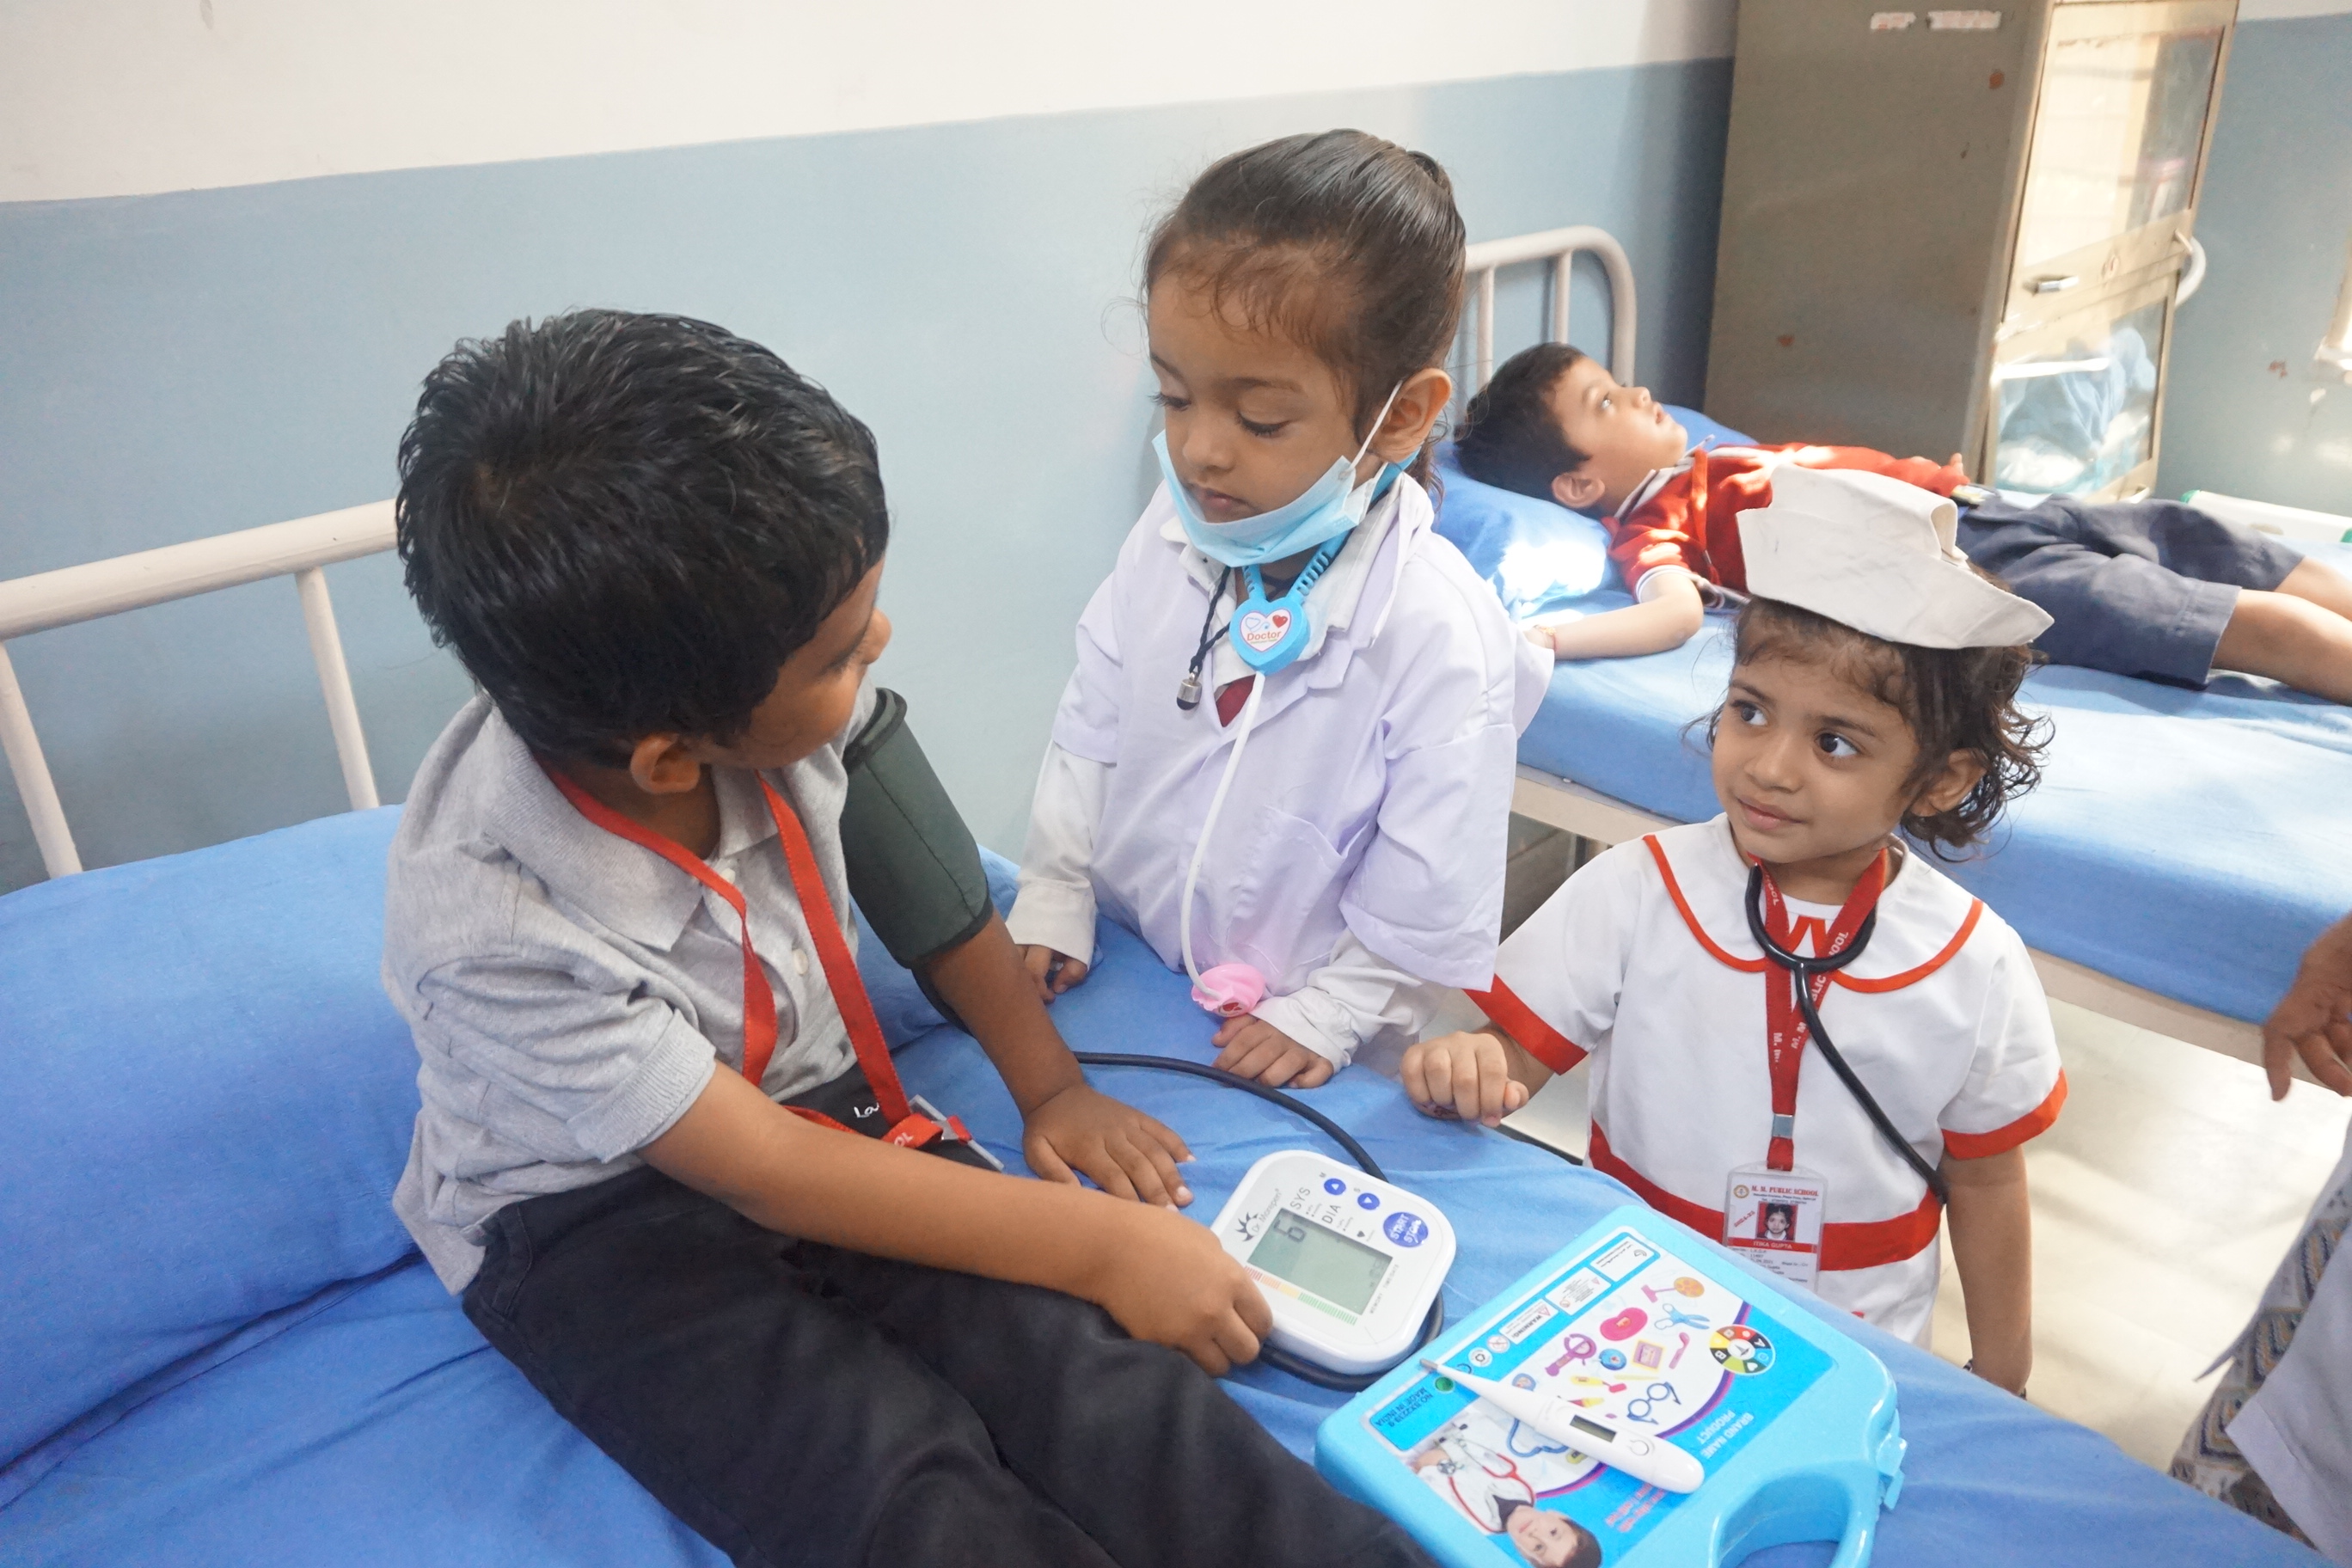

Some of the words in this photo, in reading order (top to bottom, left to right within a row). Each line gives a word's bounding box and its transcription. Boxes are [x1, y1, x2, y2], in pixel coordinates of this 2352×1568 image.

[1246, 631, 1282, 641] Doctor
[1289, 1187, 1311, 1210] SYS
[1794, 1188, 1819, 1197] SCHOOL
[1321, 1204, 1342, 1224] DIA
[1389, 1213, 1410, 1240] START
[1754, 1338, 1766, 1347] A
[1714, 1350, 1727, 1360] B
[1406, 1387, 1427, 1406] MADE
[1375, 1409, 1397, 1426] INDIA
[1696, 1409, 1736, 1444] PRODUCT
[1724, 1412, 1755, 1439] BRAND
[1700, 1435, 1728, 1460] NAME
